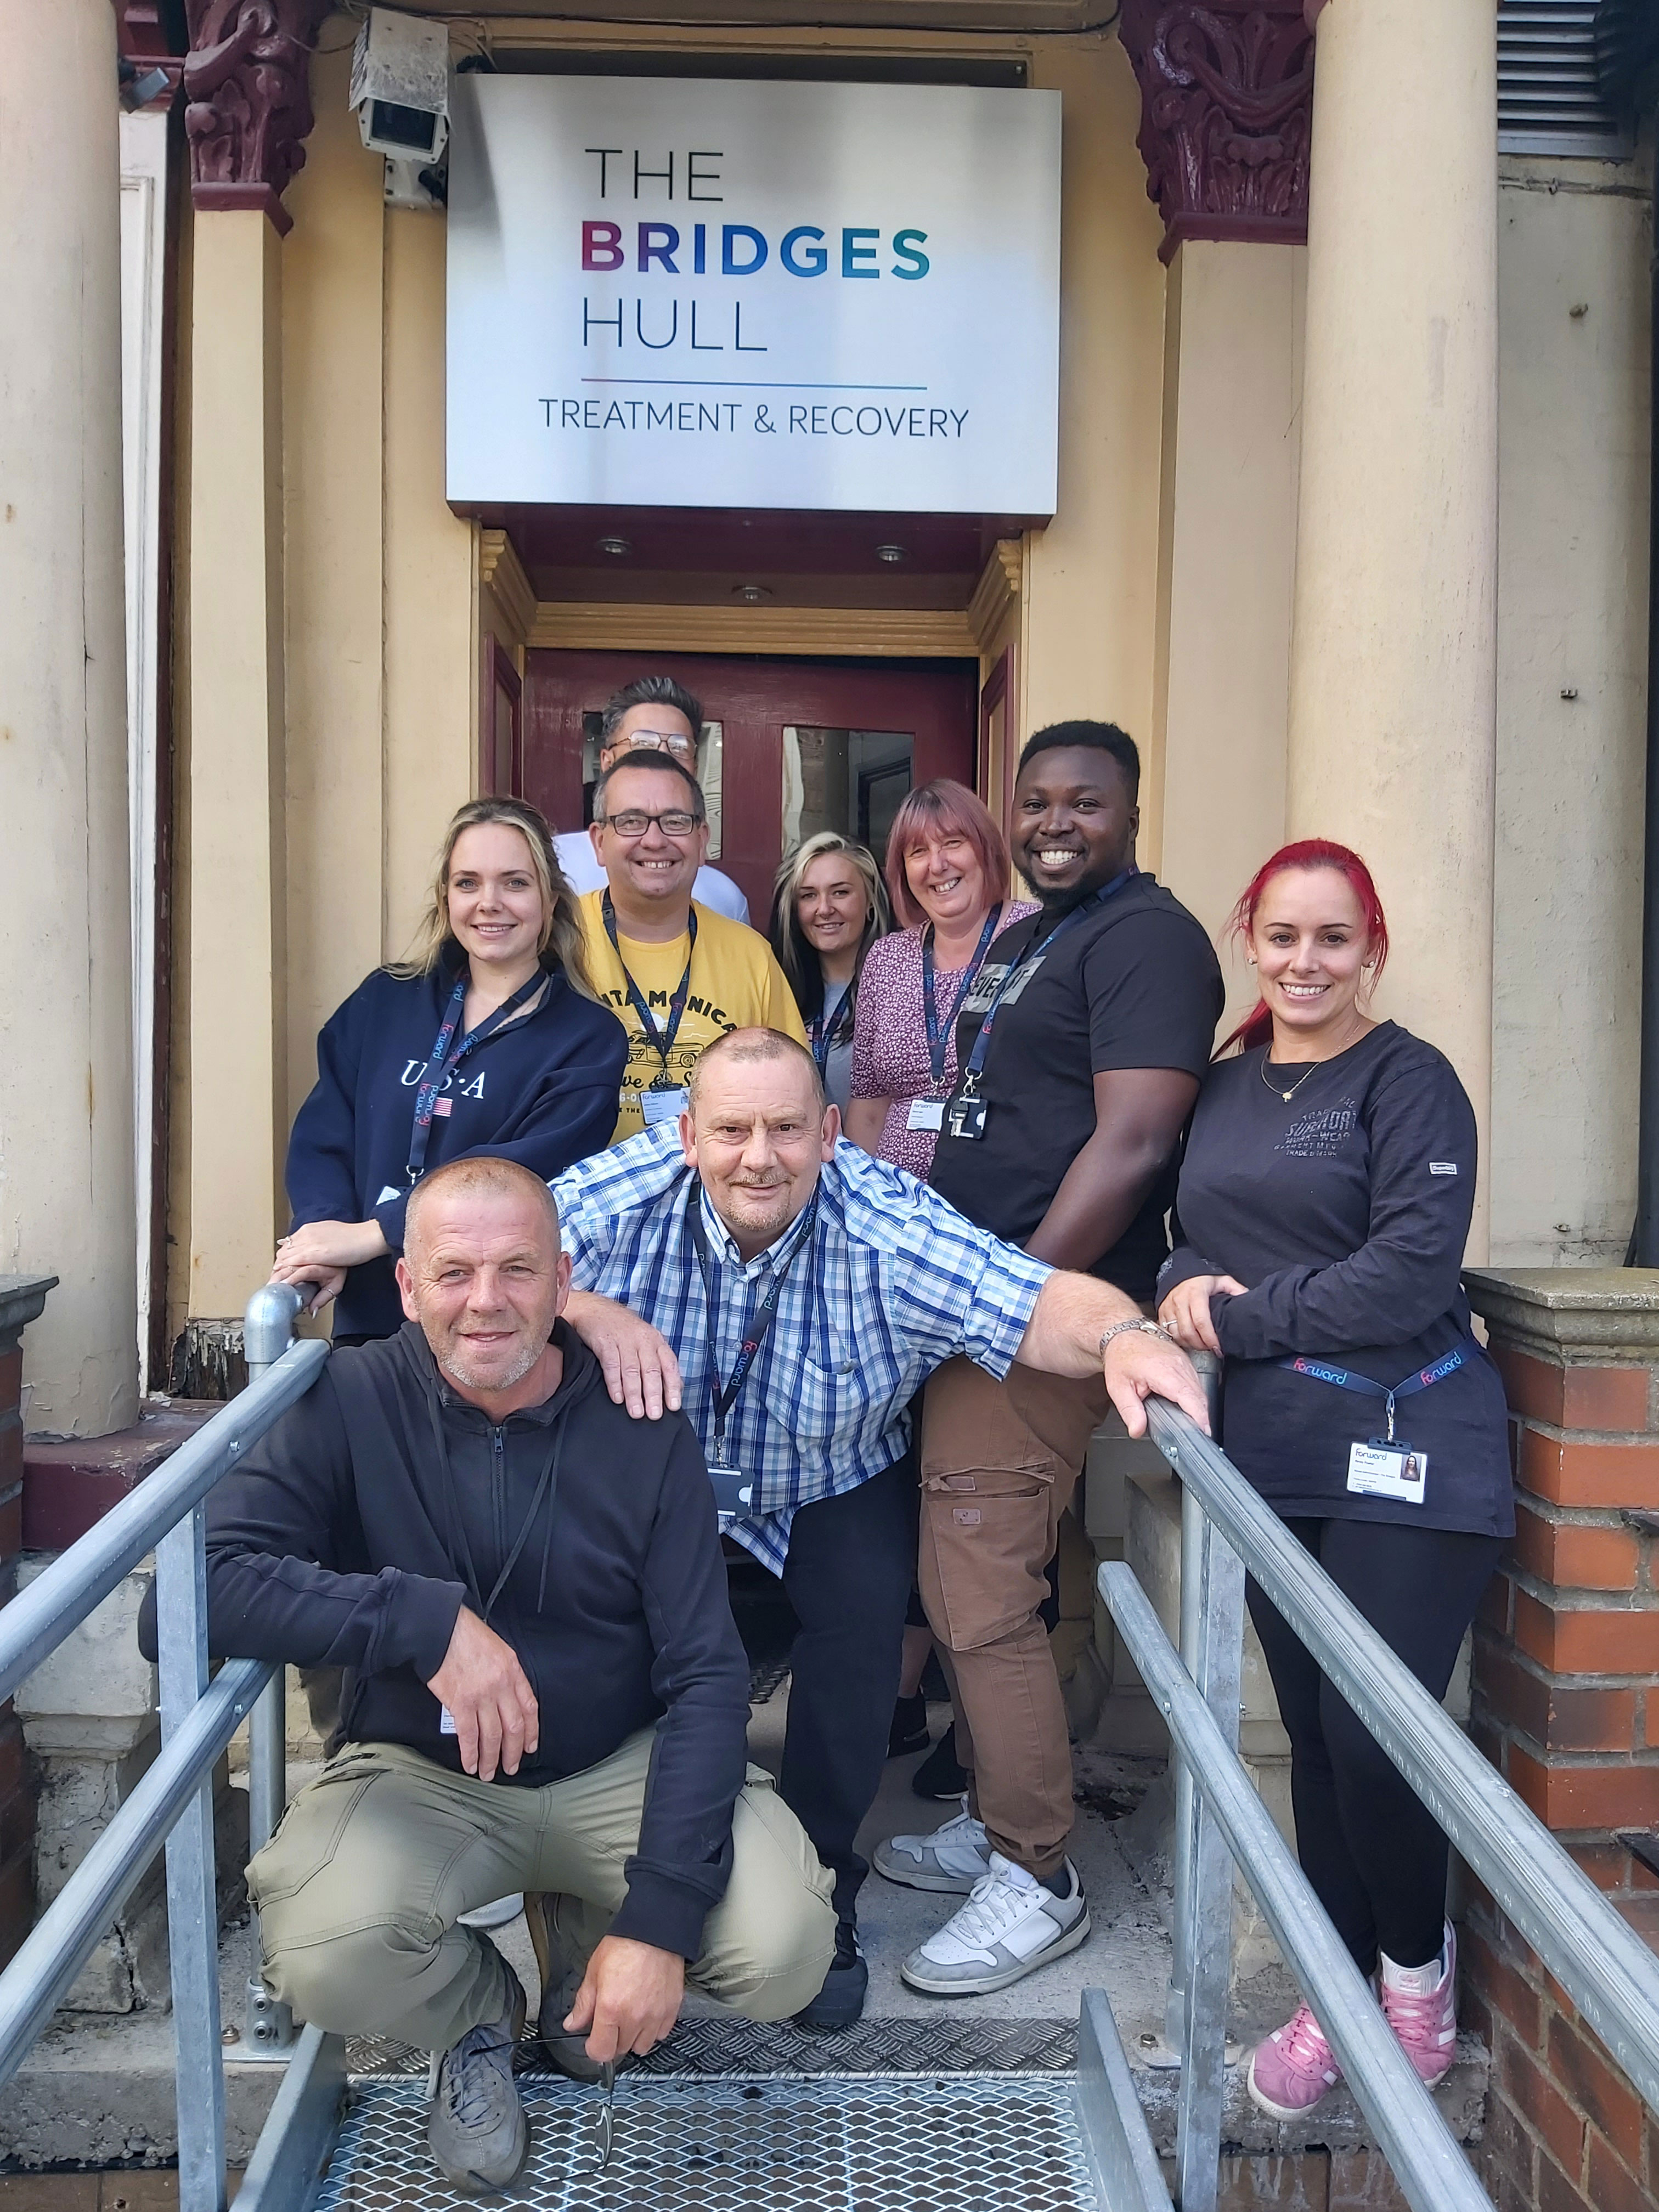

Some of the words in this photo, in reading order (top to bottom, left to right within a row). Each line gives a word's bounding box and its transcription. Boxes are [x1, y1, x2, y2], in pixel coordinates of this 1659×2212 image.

[585, 149, 724, 202] THE
[581, 221, 930, 280] BRIDGES
[583, 297, 768, 351] HULL
[538, 399, 742, 432] TREATMENT
[754, 405, 777, 434] &
[789, 405, 969, 438] RECOVERY
[432, 1023, 454, 1060] forward
[731, 1340, 758, 1387] forward
[1293, 1357, 1347, 1385] forward
[1420, 1351, 1463, 1386] forward
[1355, 1448, 1387, 1461] forward
